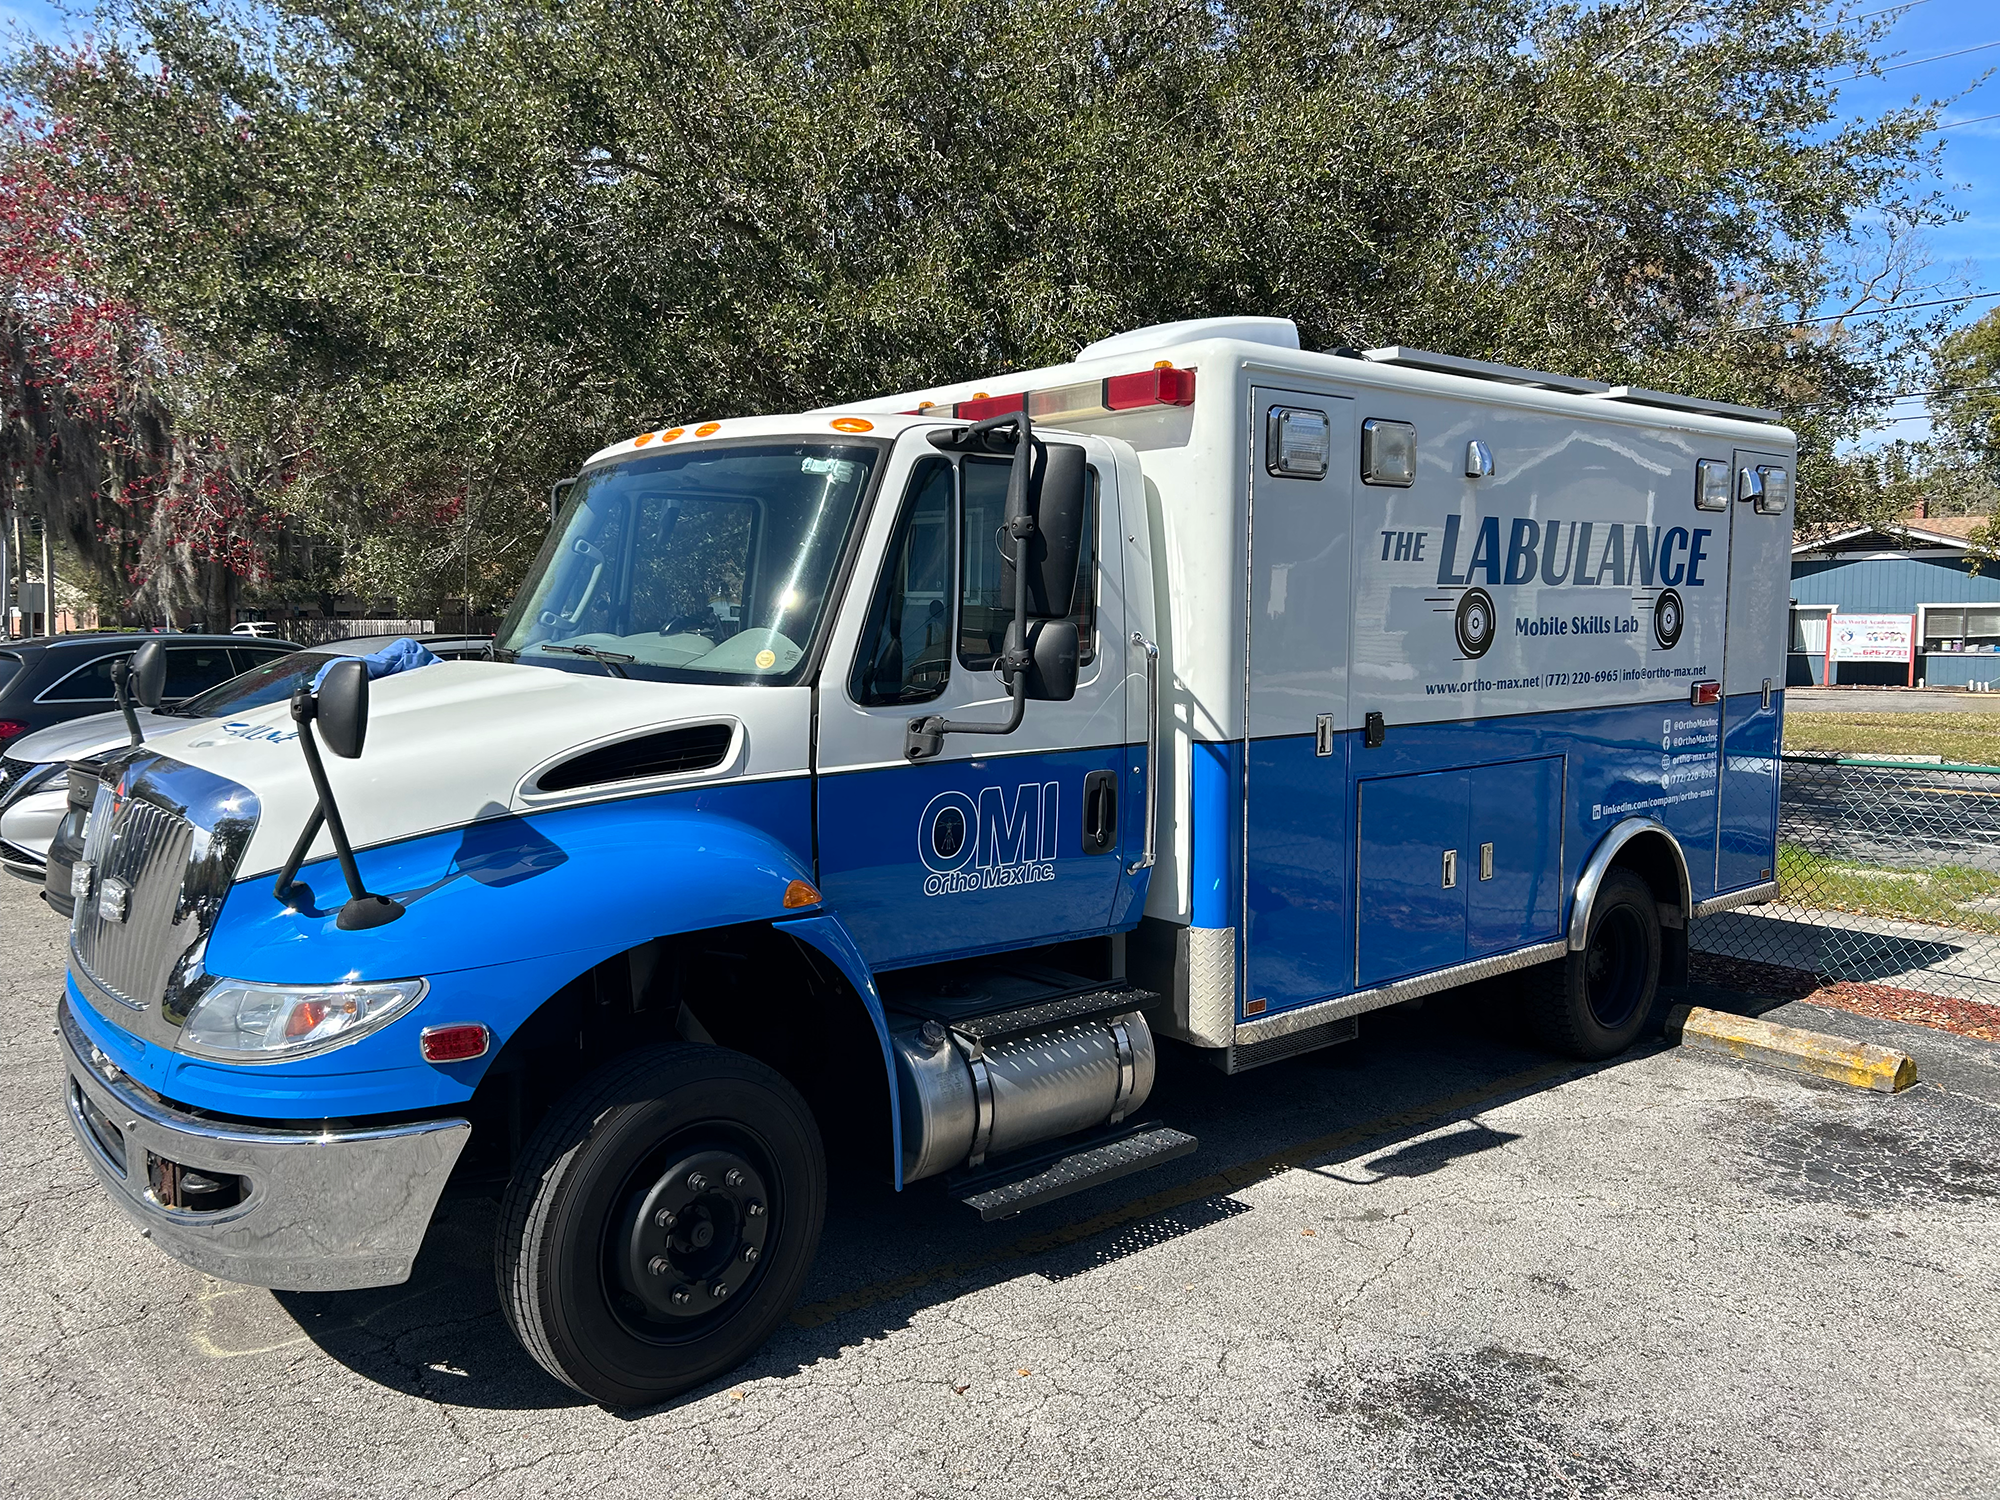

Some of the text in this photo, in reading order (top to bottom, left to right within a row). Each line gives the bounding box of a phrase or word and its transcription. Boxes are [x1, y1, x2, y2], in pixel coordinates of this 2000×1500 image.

[1381, 514, 1712, 586] THE LABULANCE
[1515, 616, 1639, 637] Mobile Skills Lab
[1425, 675, 1540, 695] www.ortho-max.net
[1545, 673, 1570, 687] (772)
[1572, 670, 1618, 685] 220-6965
[1622, 665, 1707, 681] info@ortho-max.net
[1672, 751, 1717, 764] ortho-max.net
[918, 781, 1059, 873] OMI
[923, 862, 1056, 896] Ortho Max Inc.
